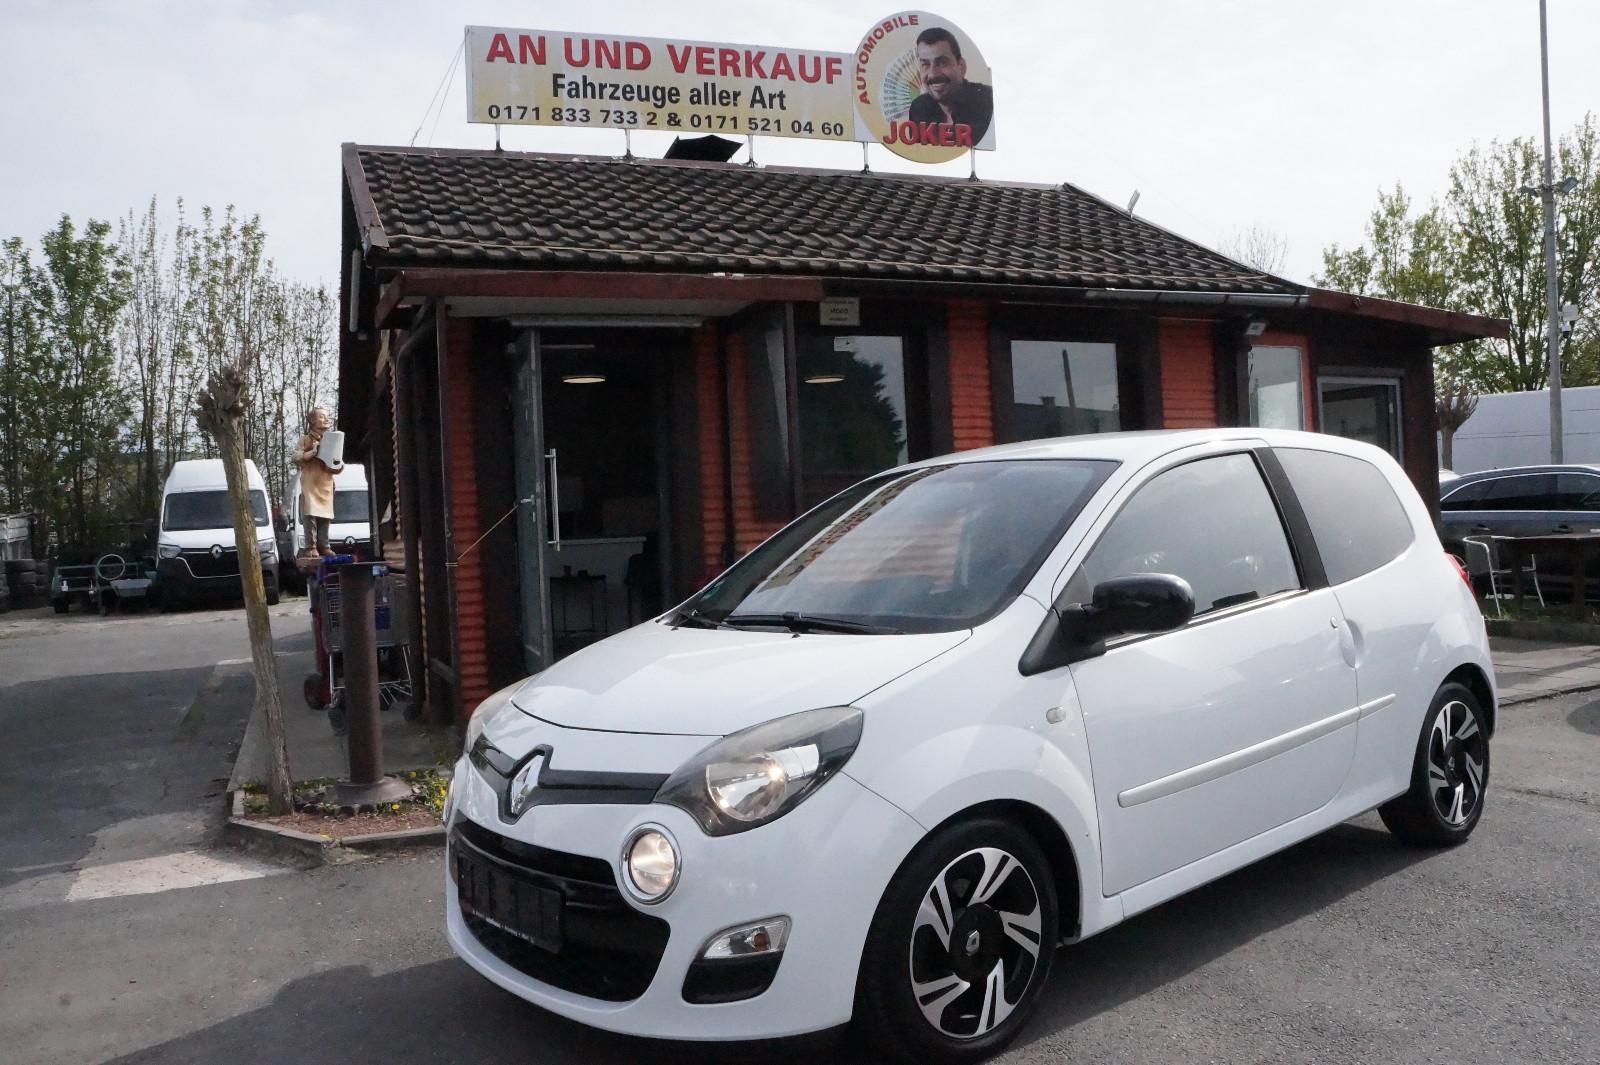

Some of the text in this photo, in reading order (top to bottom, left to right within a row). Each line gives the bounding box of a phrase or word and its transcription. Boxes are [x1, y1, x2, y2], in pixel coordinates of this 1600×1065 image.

[486, 33, 842, 84] AN UND VERKAUF
[856, 15, 919, 105] AUTOMOBILE
[552, 73, 787, 110] Fahrzeuge aller Art
[488, 104, 844, 136] 0171 833 733 2 & 0171 521 04 60
[882, 120, 974, 147] JOKER
